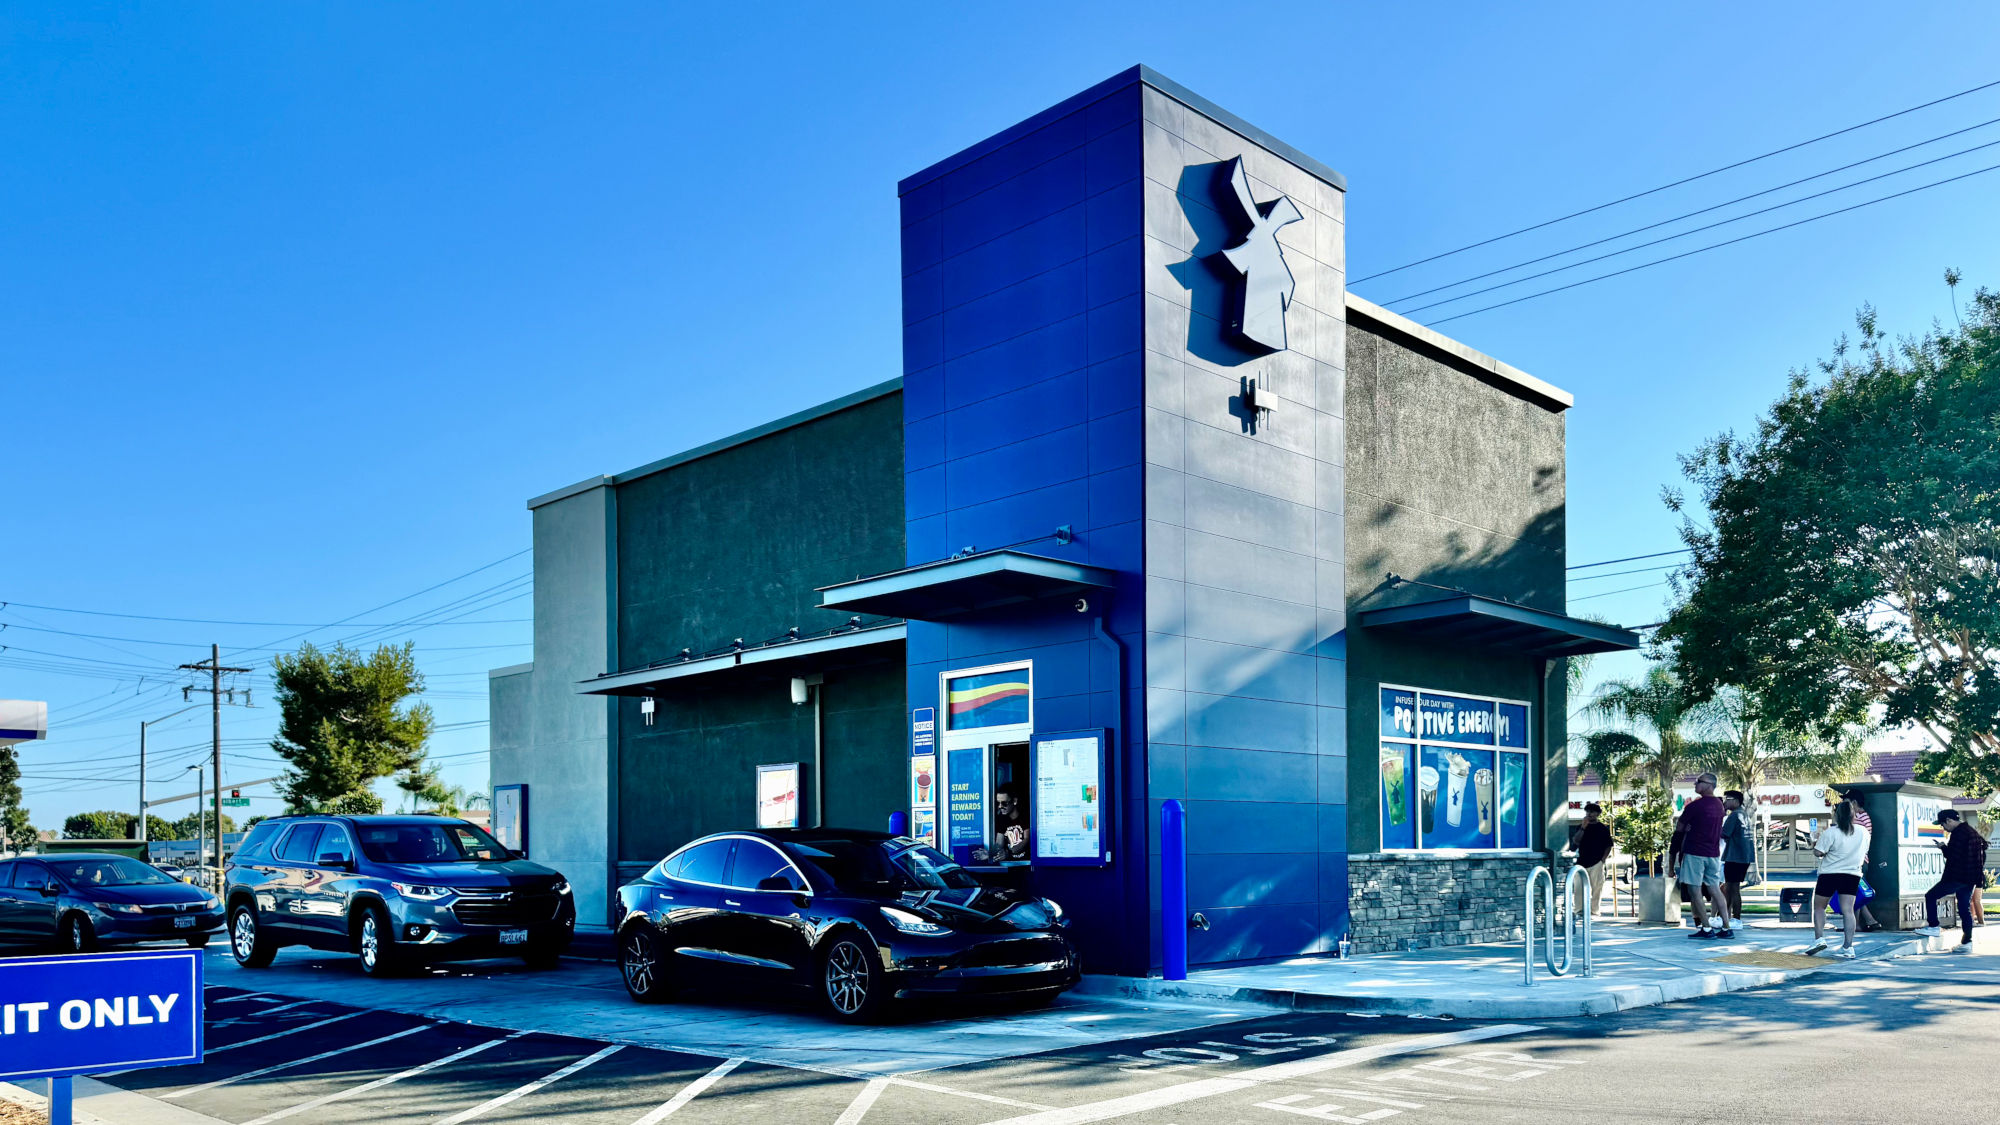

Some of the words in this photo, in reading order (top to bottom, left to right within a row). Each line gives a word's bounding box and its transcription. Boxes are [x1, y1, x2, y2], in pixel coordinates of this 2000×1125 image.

[1395, 695, 1414, 705] INFUSE
[1417, 698, 1430, 707] OUR
[1430, 700, 1441, 708] DAY
[1441, 701, 1455, 710] WITH
[914, 722, 933, 730] NOTICE
[951, 783, 969, 791] START
[951, 792, 980, 801] EARNING
[951, 802, 982, 811] REWARDS
[951, 813, 975, 821] TODAY!
[0, 1002, 49, 1035] IT
[59, 993, 180, 1030] ONLY
[1252, 1051, 1588, 1125] ENTER
